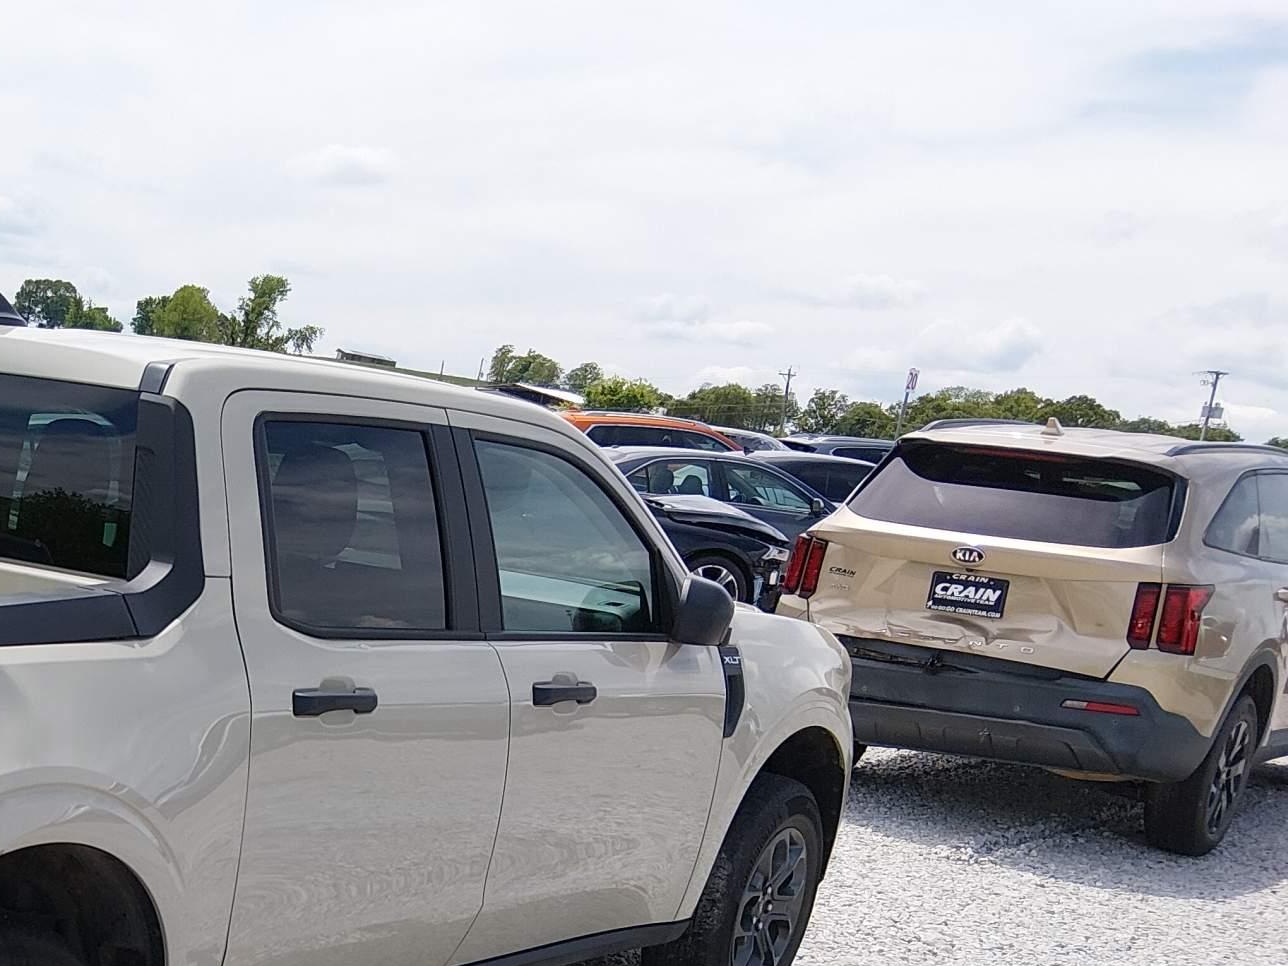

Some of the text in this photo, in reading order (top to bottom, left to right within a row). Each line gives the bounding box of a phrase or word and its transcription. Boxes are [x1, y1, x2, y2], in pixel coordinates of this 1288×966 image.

[956, 549, 980, 562] KIA
[829, 566, 857, 576] CRAIN
[952, 573, 989, 583] CRAIN
[934, 582, 1002, 602] CRAIN
[723, 656, 741, 664] XLT
